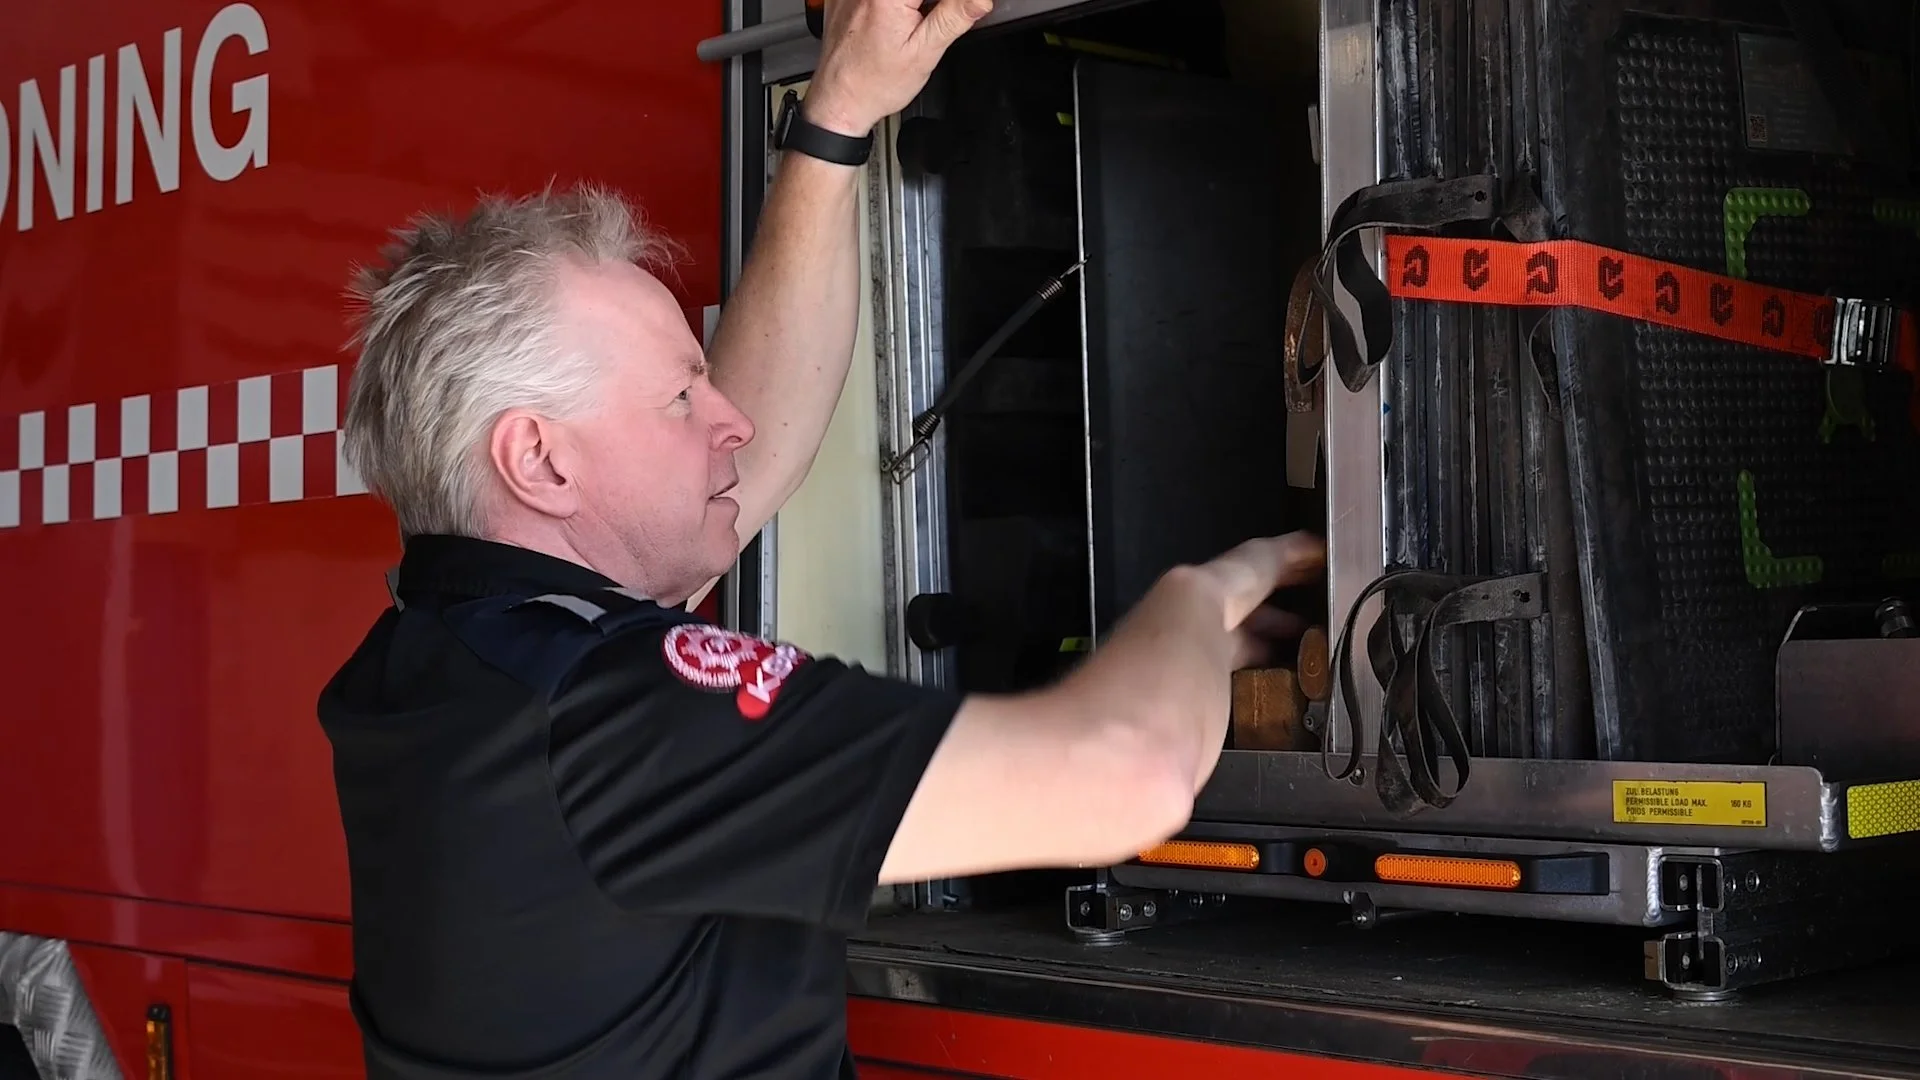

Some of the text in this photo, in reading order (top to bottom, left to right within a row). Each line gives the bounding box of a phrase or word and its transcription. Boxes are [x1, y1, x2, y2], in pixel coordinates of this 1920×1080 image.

[0, 2, 269, 232] NING
[1641, 787, 1679, 796] BELASTUNG
[1625, 797, 1669, 806] PERMISSIBLE
[1671, 798, 1689, 807] LOAD
[1742, 800, 1752, 808] KG
[1626, 806, 1693, 817] POIDS PERMISSIBLE
